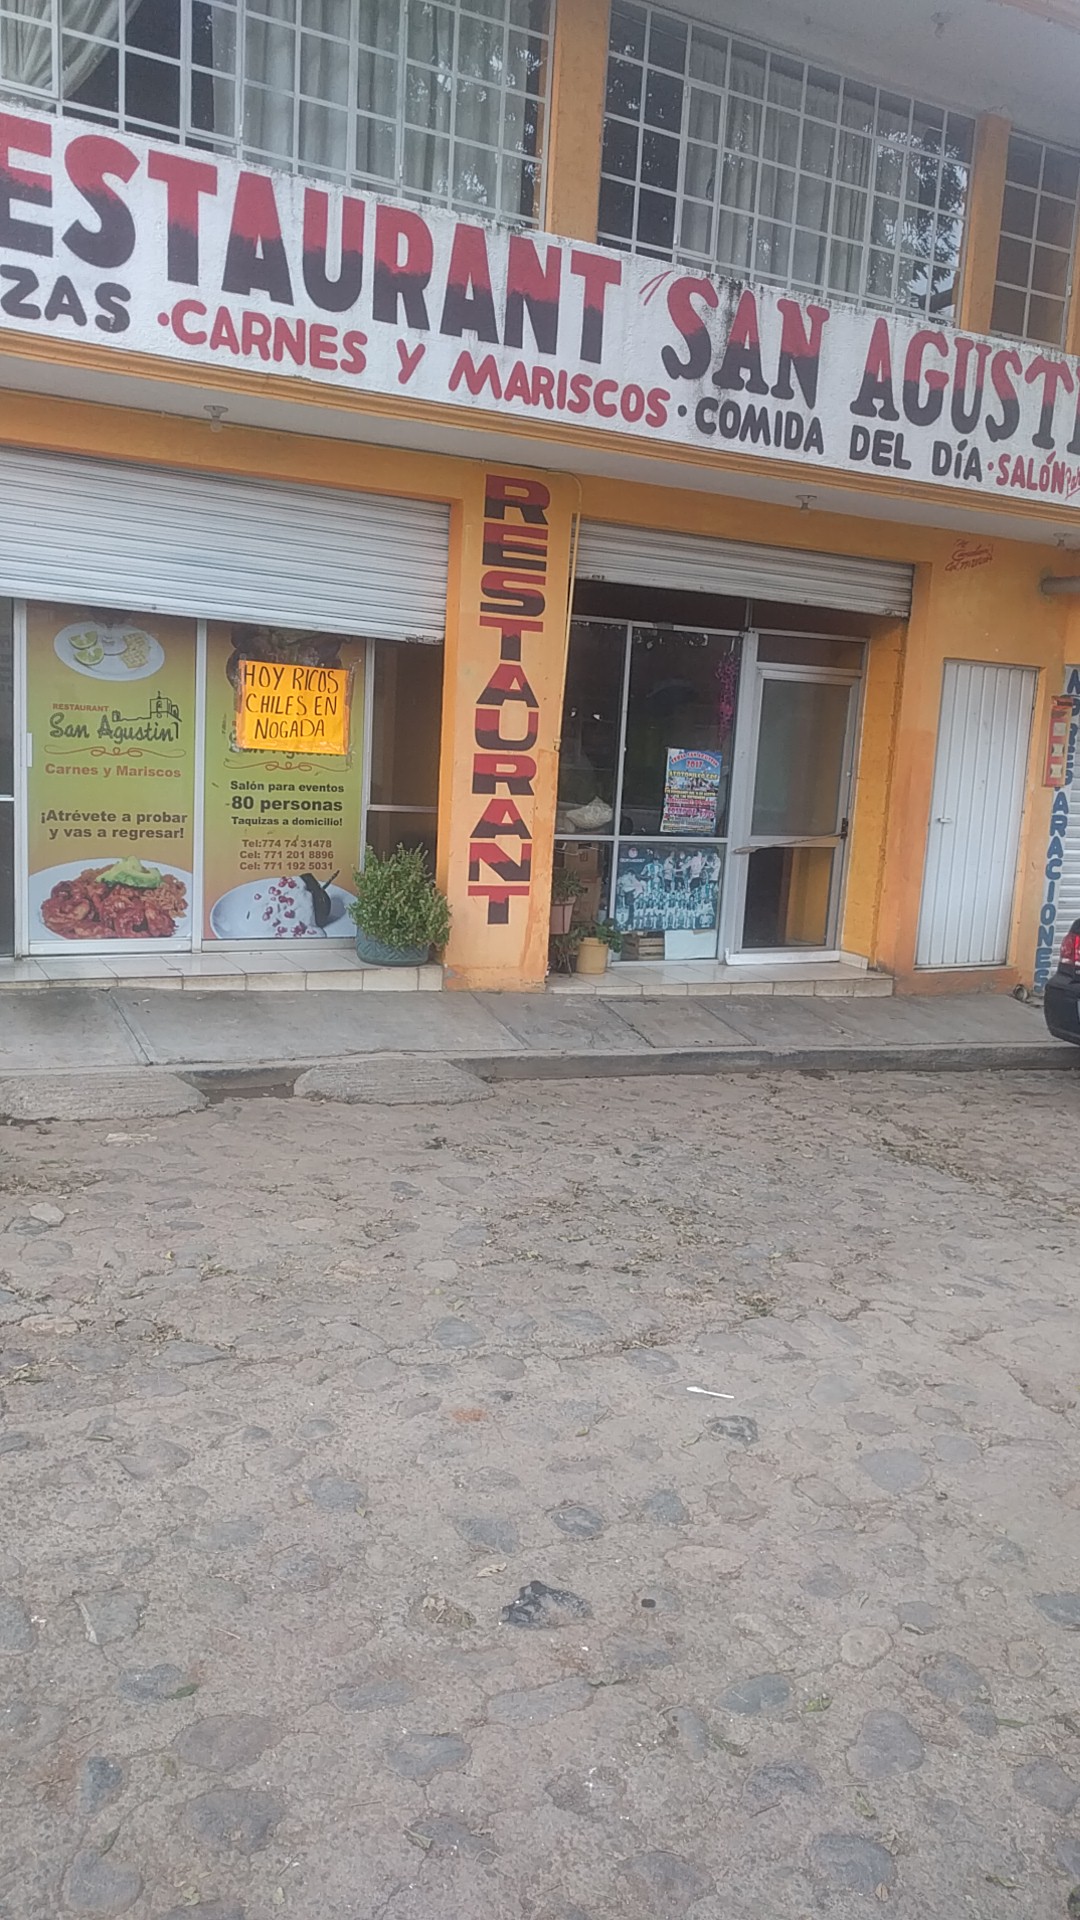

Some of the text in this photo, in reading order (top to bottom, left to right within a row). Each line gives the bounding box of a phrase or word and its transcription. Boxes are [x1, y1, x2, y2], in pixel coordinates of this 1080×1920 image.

[0, 112, 622, 364] ESTAURANT
[0, 264, 131, 333] ZAS
[449, 350, 671, 428] MARISCOS
[695, 396, 824, 455] COMIDA
[850, 424, 912, 470] DEL
[932, 438, 983, 483] DÍA
[996, 450, 1065, 494] SALÓN
[244, 664, 339, 694] HOY RICOS
[52, 703, 110, 712] RESTAURANT
[246, 693, 338, 716] CHILES EN
[467, 474, 550, 925] RESTAURANT
[49, 712, 90, 738] San
[254, 717, 325, 739] NOGADA
[45, 763, 181, 778] Carnes y Mariscos
[230, 780, 344, 793] Salón para eventos
[231, 796, 343, 813] 80 personas
[41, 809, 188, 825] ¡Atrévete a probar
[231, 816, 279, 826] Taquizas
[292, 817, 343, 826] domicilio!
[49, 828, 184, 840] y vas a regresar!
[284, 839, 297, 848] 74
[300, 839, 332, 848] 31478
[240, 850, 334, 859] Cel: 771 201 8896
[240, 861, 333, 870] Cel: 771 192 5031
